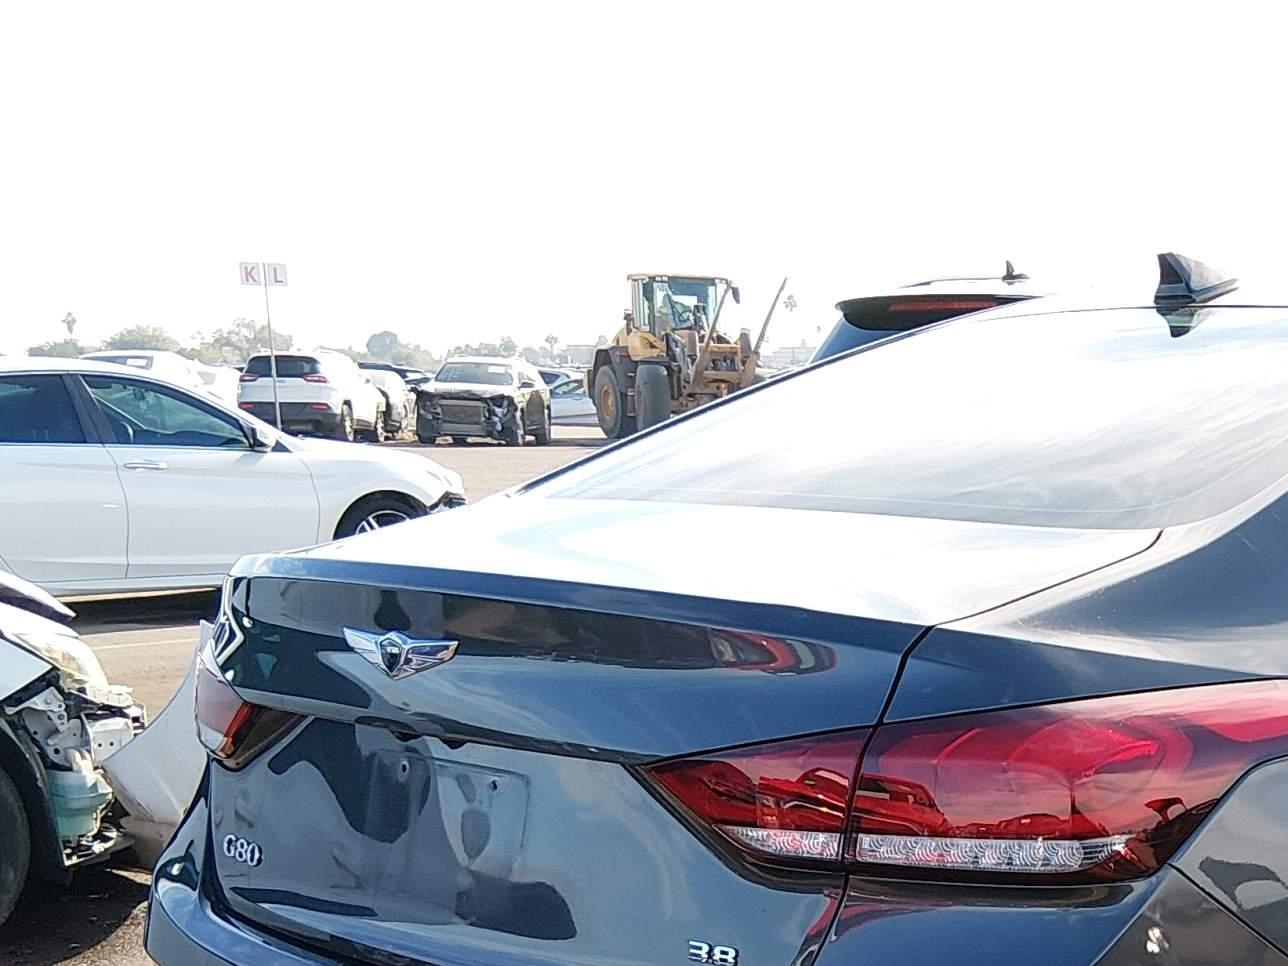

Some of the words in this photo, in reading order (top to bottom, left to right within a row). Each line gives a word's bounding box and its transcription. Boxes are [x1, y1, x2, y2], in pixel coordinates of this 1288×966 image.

[244, 265, 257, 283] K
[273, 266, 284, 284] L
[223, 833, 262, 867] G80
